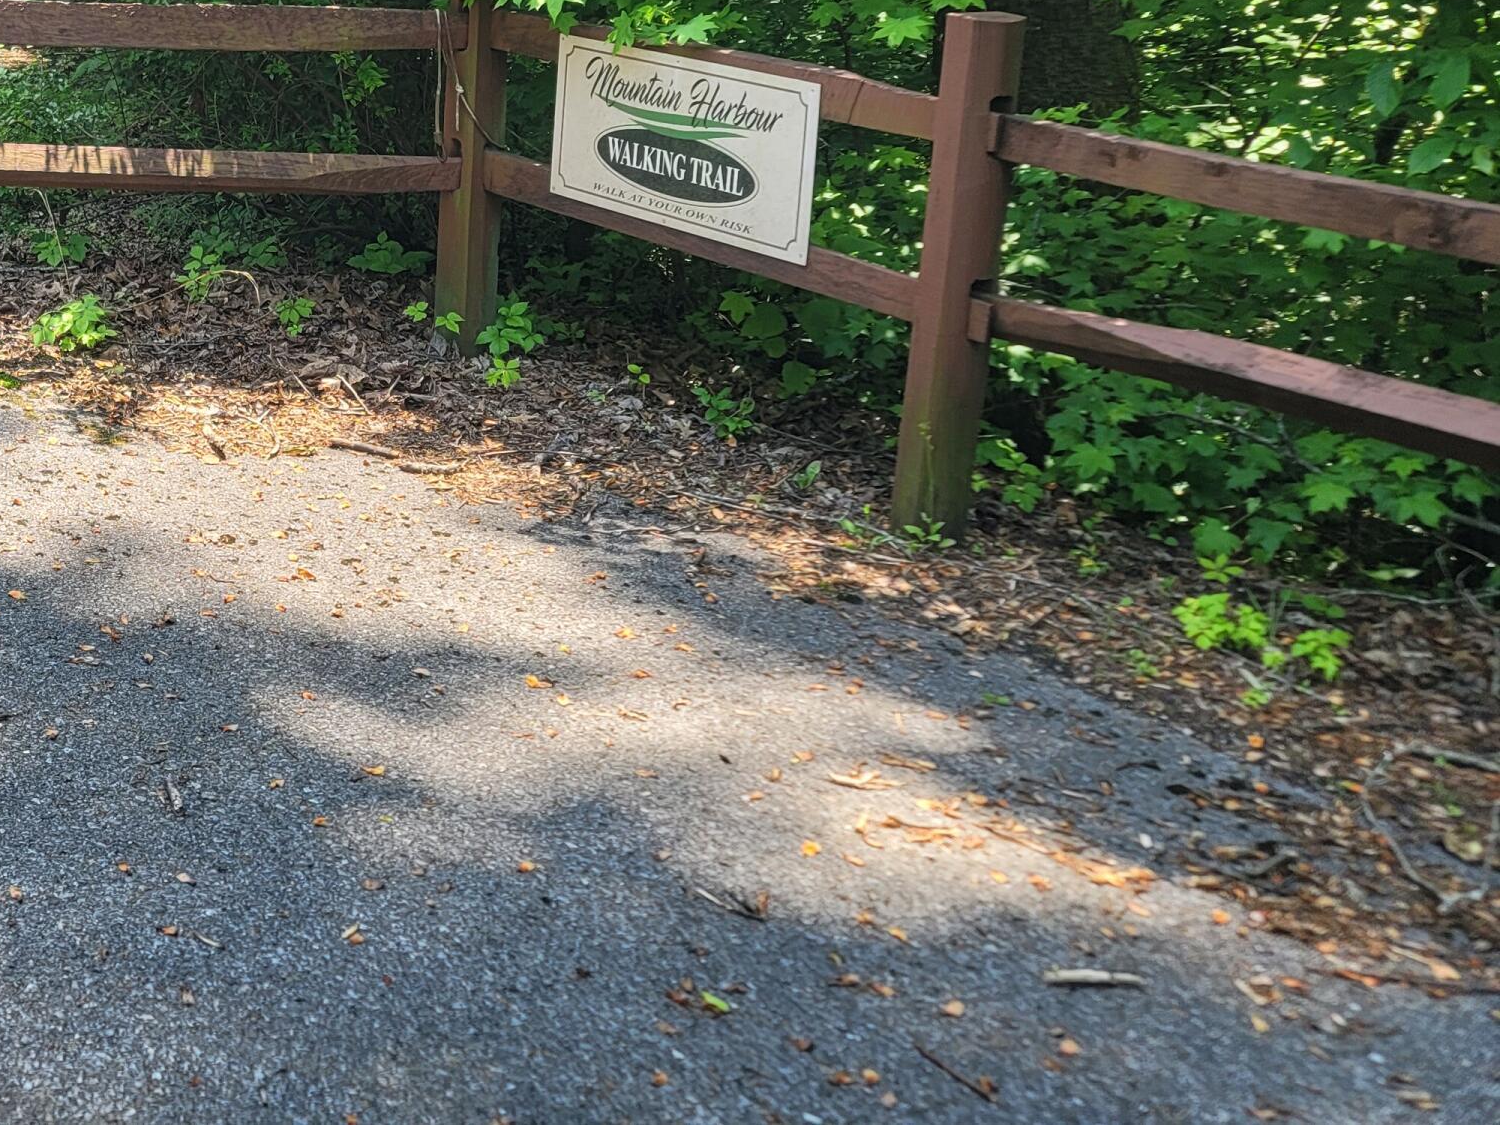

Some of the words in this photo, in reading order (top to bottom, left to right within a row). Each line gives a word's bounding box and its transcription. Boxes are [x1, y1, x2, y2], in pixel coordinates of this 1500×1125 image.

[585, 56, 683, 111] Mountain
[689, 78, 783, 132] Harbour
[607, 136, 686, 181] WALKING
[690, 157, 744, 196] TRAIL
[593, 182, 628, 199] WALK
[629, 192, 645, 204] AT
[647, 198, 682, 215] YOUR
[685, 209, 717, 224] OWN
[720, 218, 754, 235] RISK
